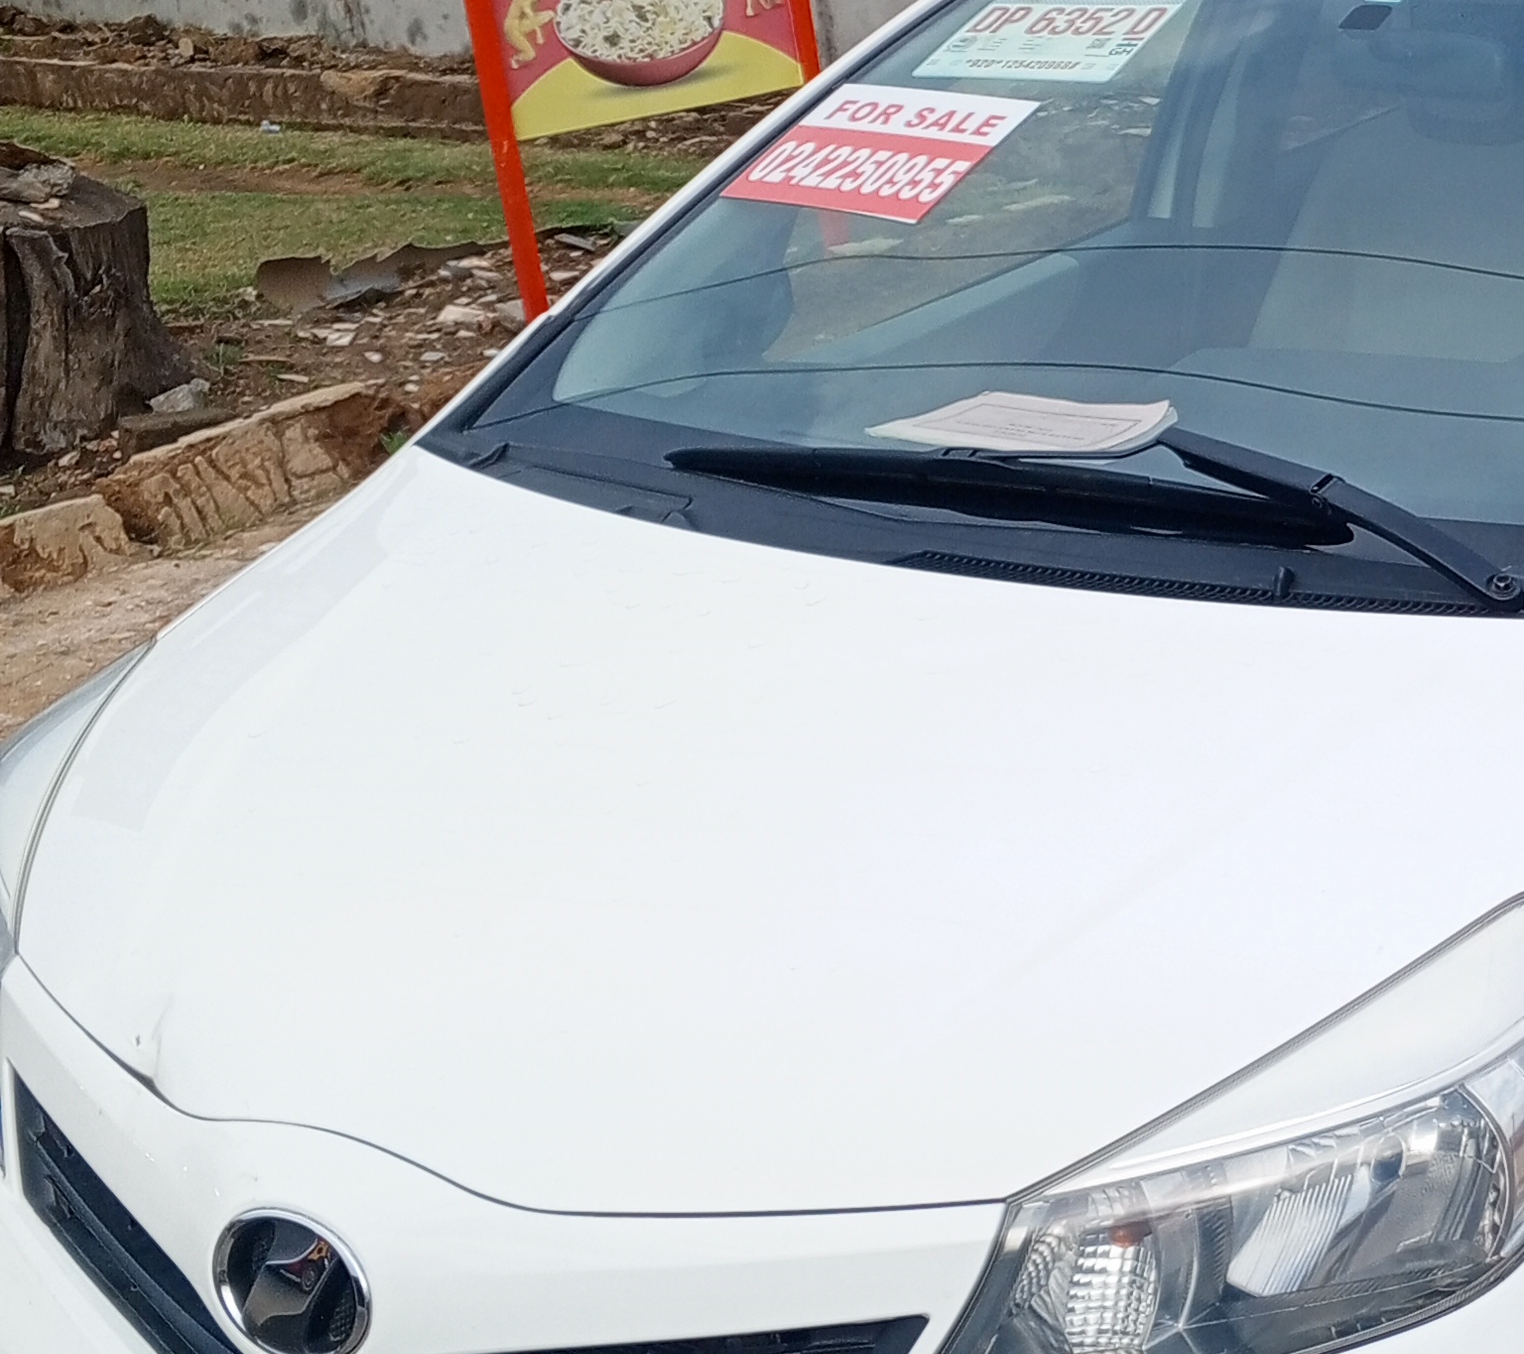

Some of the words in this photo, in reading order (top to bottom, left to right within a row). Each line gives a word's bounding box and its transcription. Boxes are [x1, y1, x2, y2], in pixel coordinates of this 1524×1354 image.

[966, 5, 1034, 34] DP
[1024, 6, 1137, 37] 6352
[1122, 7, 1169, 36] D
[1108, 46, 1134, 56] GH
[823, 99, 905, 126] FOR
[903, 106, 1008, 138] SALE
[747, 140, 974, 204] 0242250955
